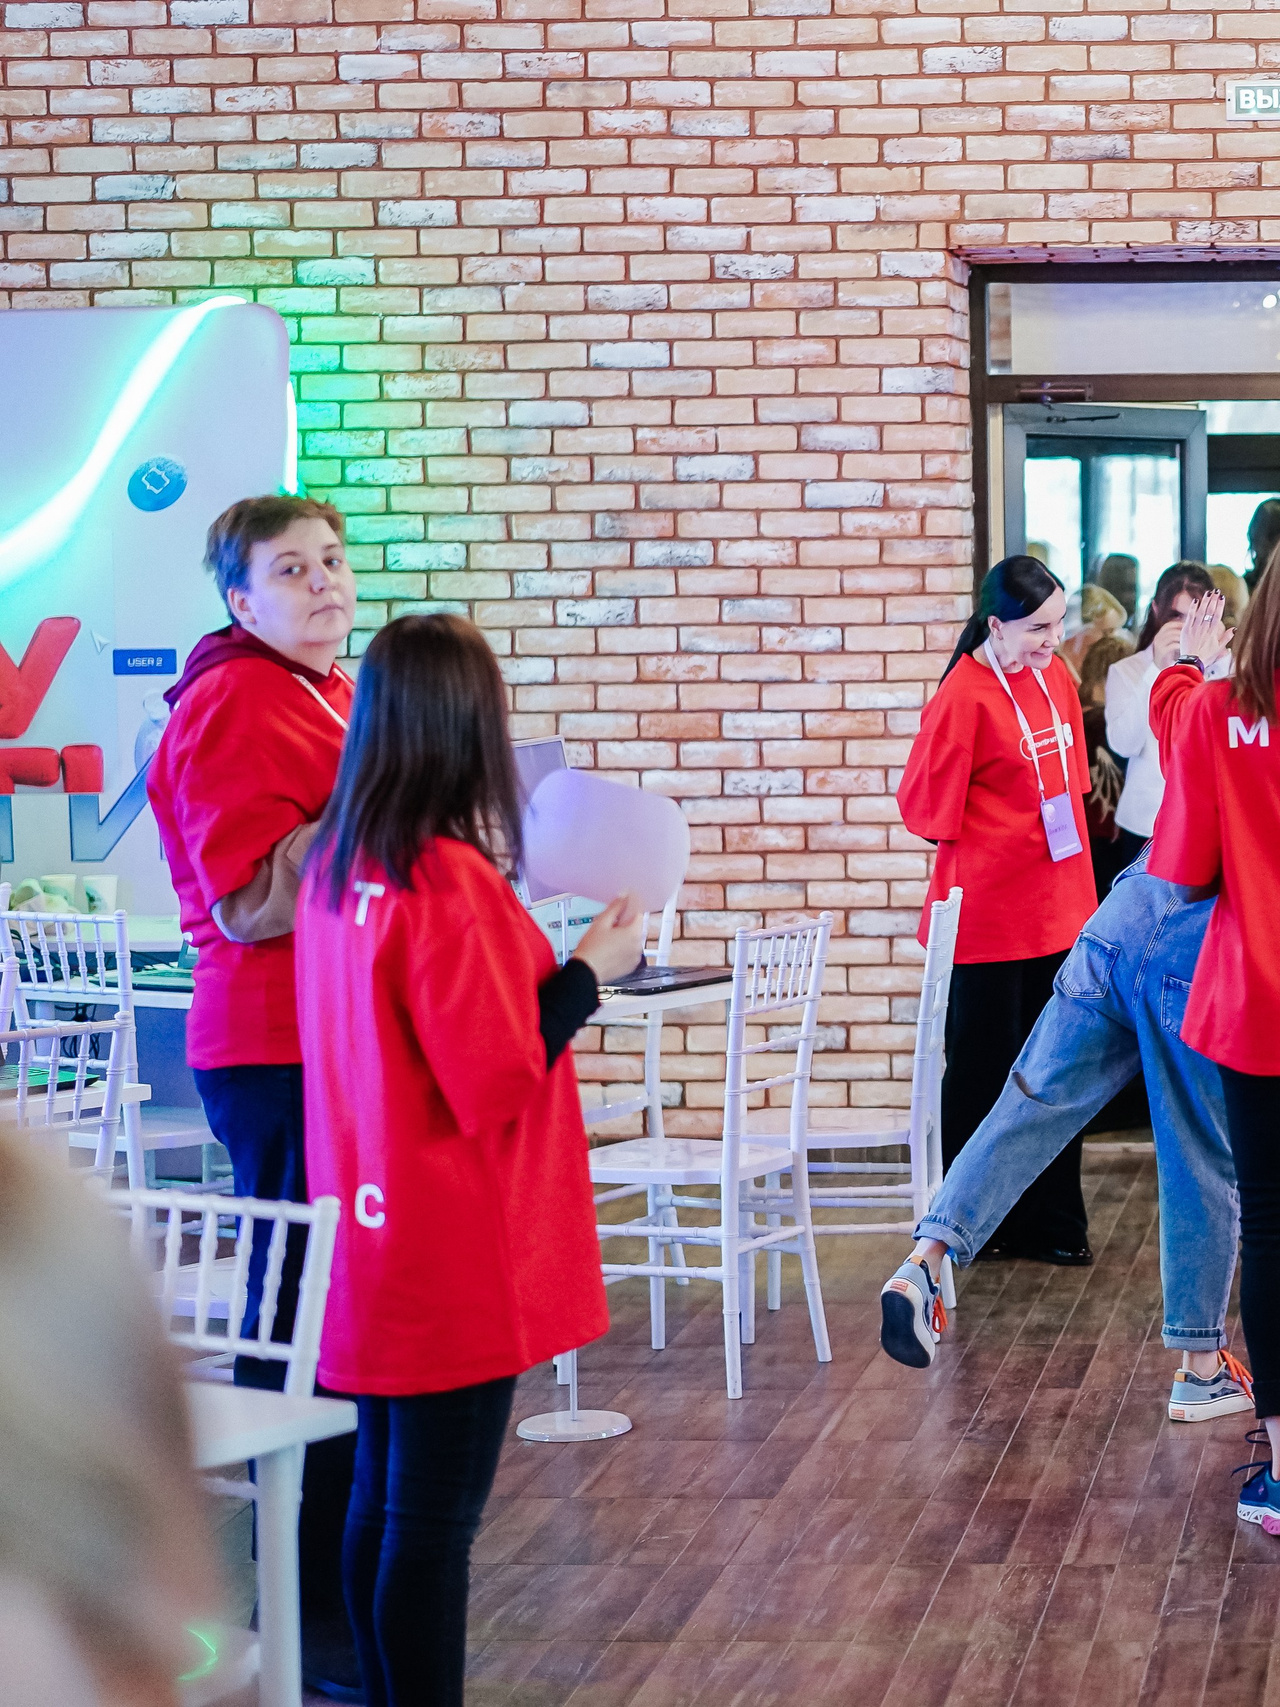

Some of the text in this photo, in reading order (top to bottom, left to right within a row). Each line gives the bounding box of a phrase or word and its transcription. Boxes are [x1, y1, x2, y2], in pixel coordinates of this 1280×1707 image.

[127, 656, 163, 667] USER 2
[1227, 716, 1270, 749] М
[354, 880, 386, 927] Т
[354, 1183, 386, 1229] С
